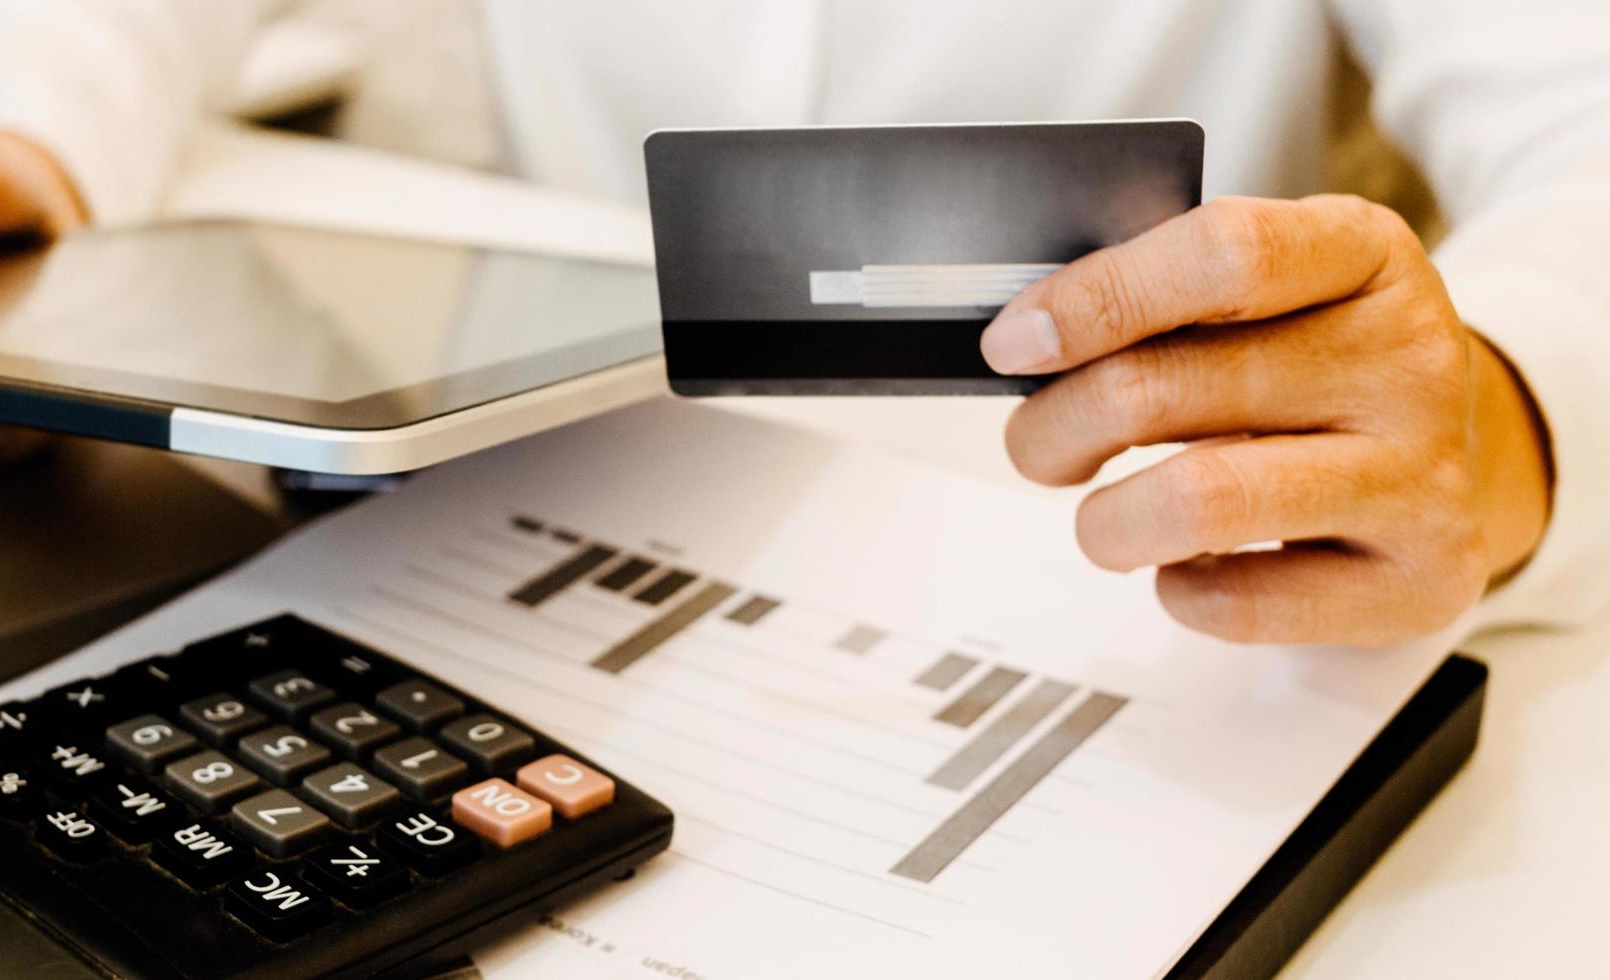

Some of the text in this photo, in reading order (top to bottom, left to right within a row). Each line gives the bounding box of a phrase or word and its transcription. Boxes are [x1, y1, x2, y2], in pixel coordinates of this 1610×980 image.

[274, 677, 315, 697] 3
[203, 701, 245, 722] 6
[336, 709, 379, 733] 2
[132, 724, 173, 745] 9
[468, 723, 504, 742] 0
[263, 735, 308, 757] 5
[51, 745, 106, 777] M+
[400, 749, 438, 768] 1
[191, 761, 234, 784] 8
[329, 774, 369, 793] 4
[544, 764, 584, 785] C
[469, 783, 531, 816] ON
[46, 811, 96, 838] OFF
[256, 806, 303, 825] 7
[395, 812, 455, 846] CE
[173, 823, 234, 860] MR
[243, 871, 311, 911] MC
